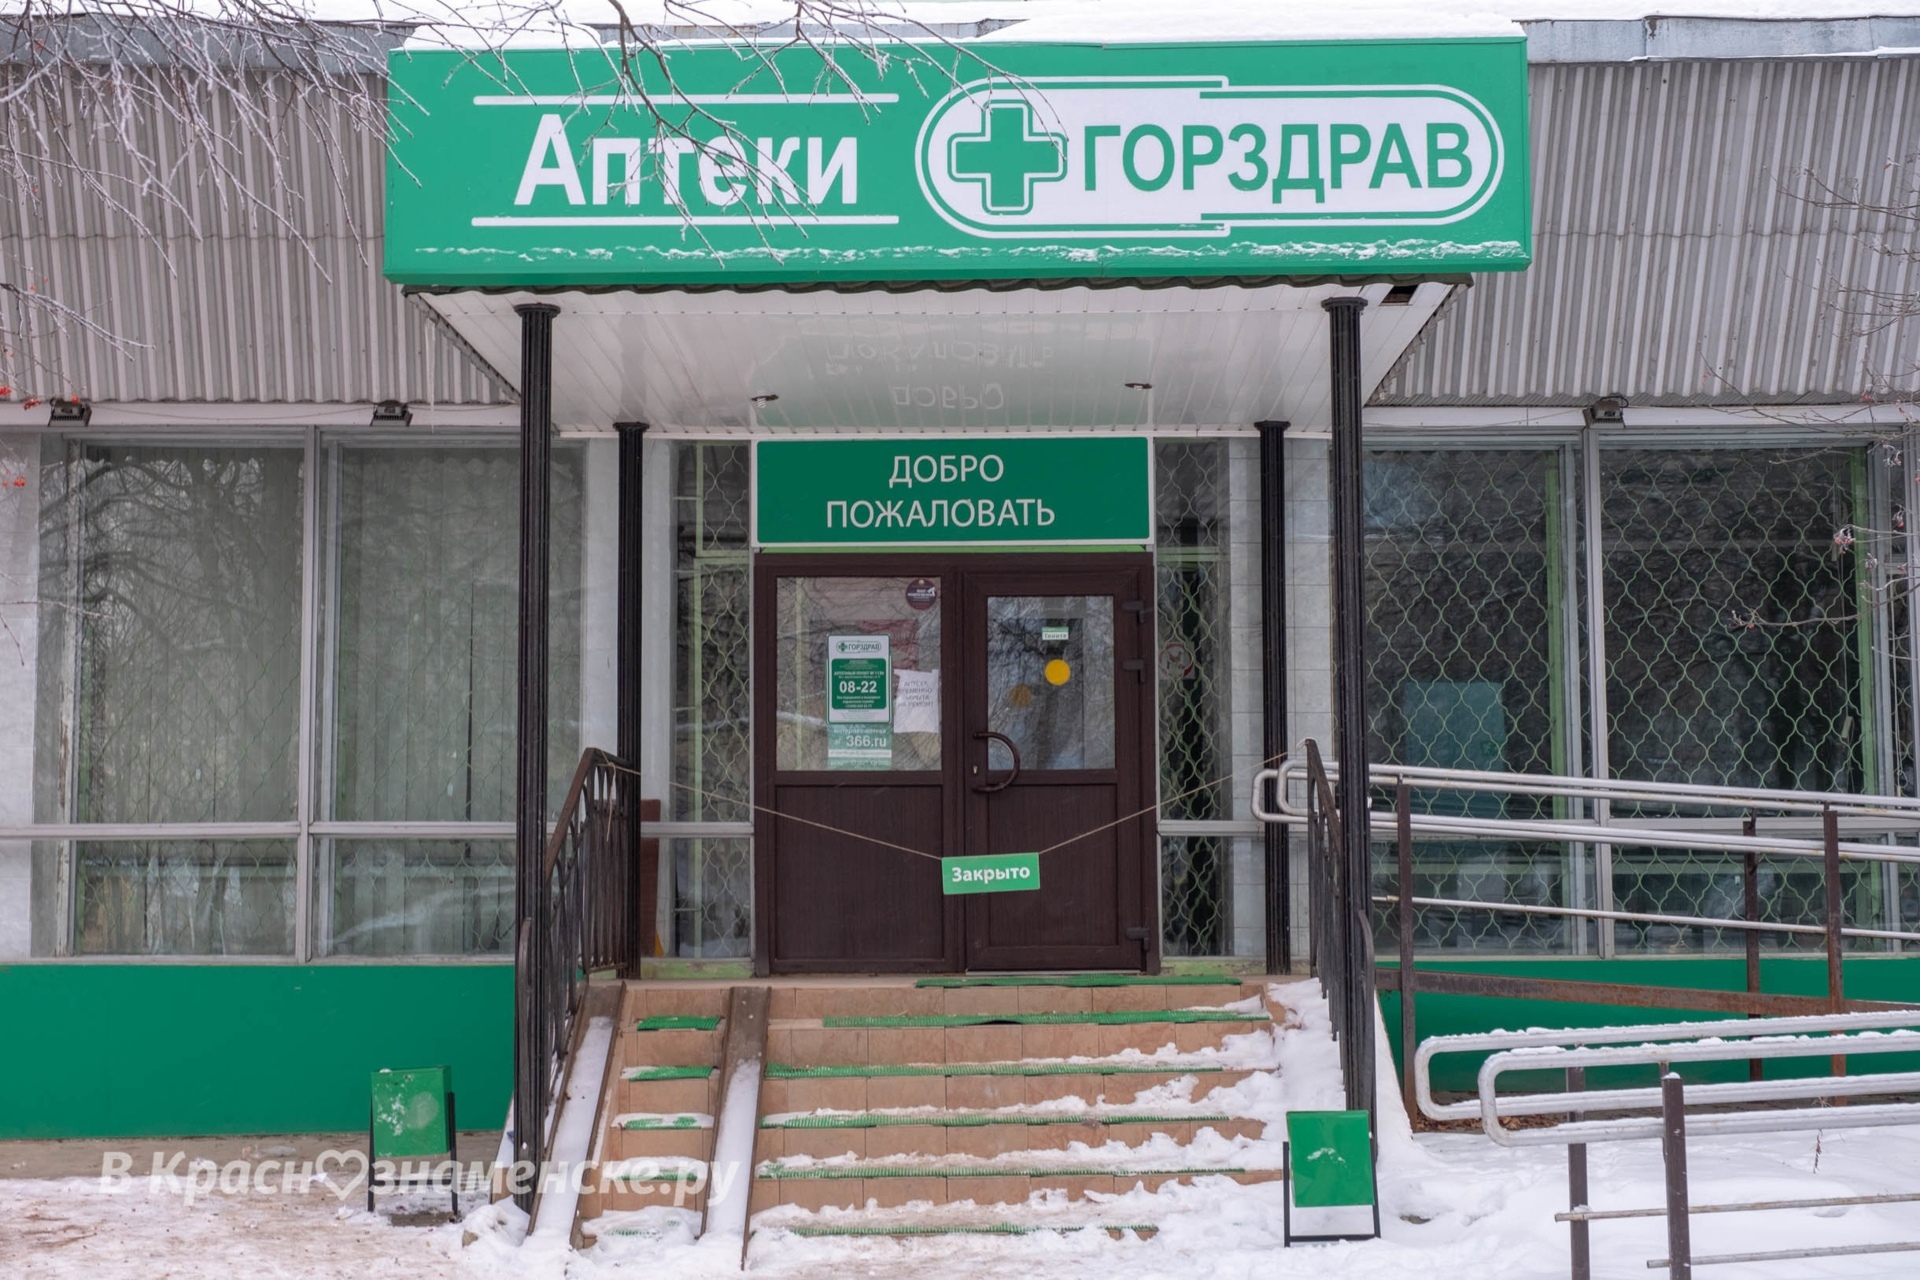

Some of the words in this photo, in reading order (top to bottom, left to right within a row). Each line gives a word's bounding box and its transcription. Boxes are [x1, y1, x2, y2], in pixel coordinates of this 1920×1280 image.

[513, 113, 859, 206] Аптеки
[1083, 121, 1474, 205] ГОРЗДРАВ
[889, 453, 1005, 488] ДОБРО
[826, 498, 1056, 528] ПОЖАЛОВАТЬ
[848, 643, 880, 651] ГОРЗДРАВ
[839, 680, 878, 693] 08-22
[846, 735, 887, 747] 366.ru
[951, 866, 1031, 884] Закрыто
